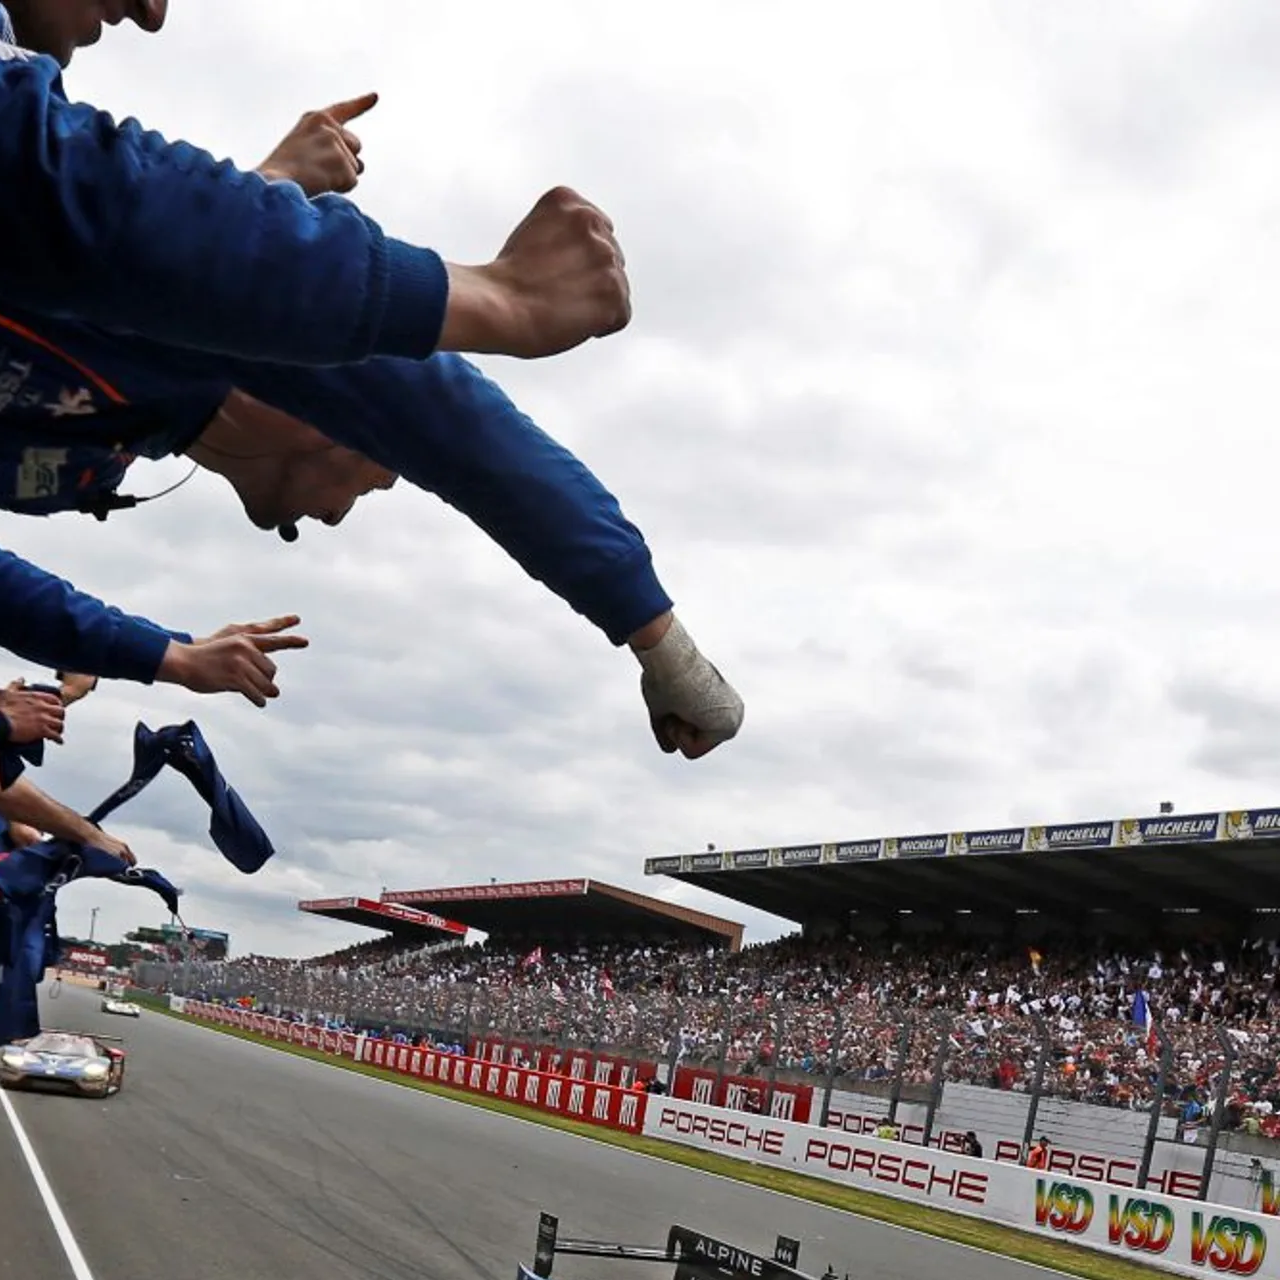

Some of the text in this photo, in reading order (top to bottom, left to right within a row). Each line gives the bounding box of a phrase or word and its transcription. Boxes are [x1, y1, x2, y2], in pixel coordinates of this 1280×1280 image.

[901, 838, 945, 850] MICHELIN
[970, 833, 1022, 848] MICHELIN
[1051, 827, 1111, 842] MICHELIN
[1145, 819, 1215, 836] MICHELIN
[619, 1093, 639, 1127] RTL
[726, 1083, 751, 1111] RT
[772, 1090, 796, 1121] RTL
[660, 1107, 785, 1155] PORSCHE
[805, 1138, 989, 1203] PORSCHE
[996, 1141, 1204, 1199] PRSCHE
[1035, 1178, 1095, 1235] VSD
[1108, 1194, 1175, 1254] VSD
[695, 1239, 763, 1277] ALPINE
[1191, 1211, 1267, 1276] VSD
